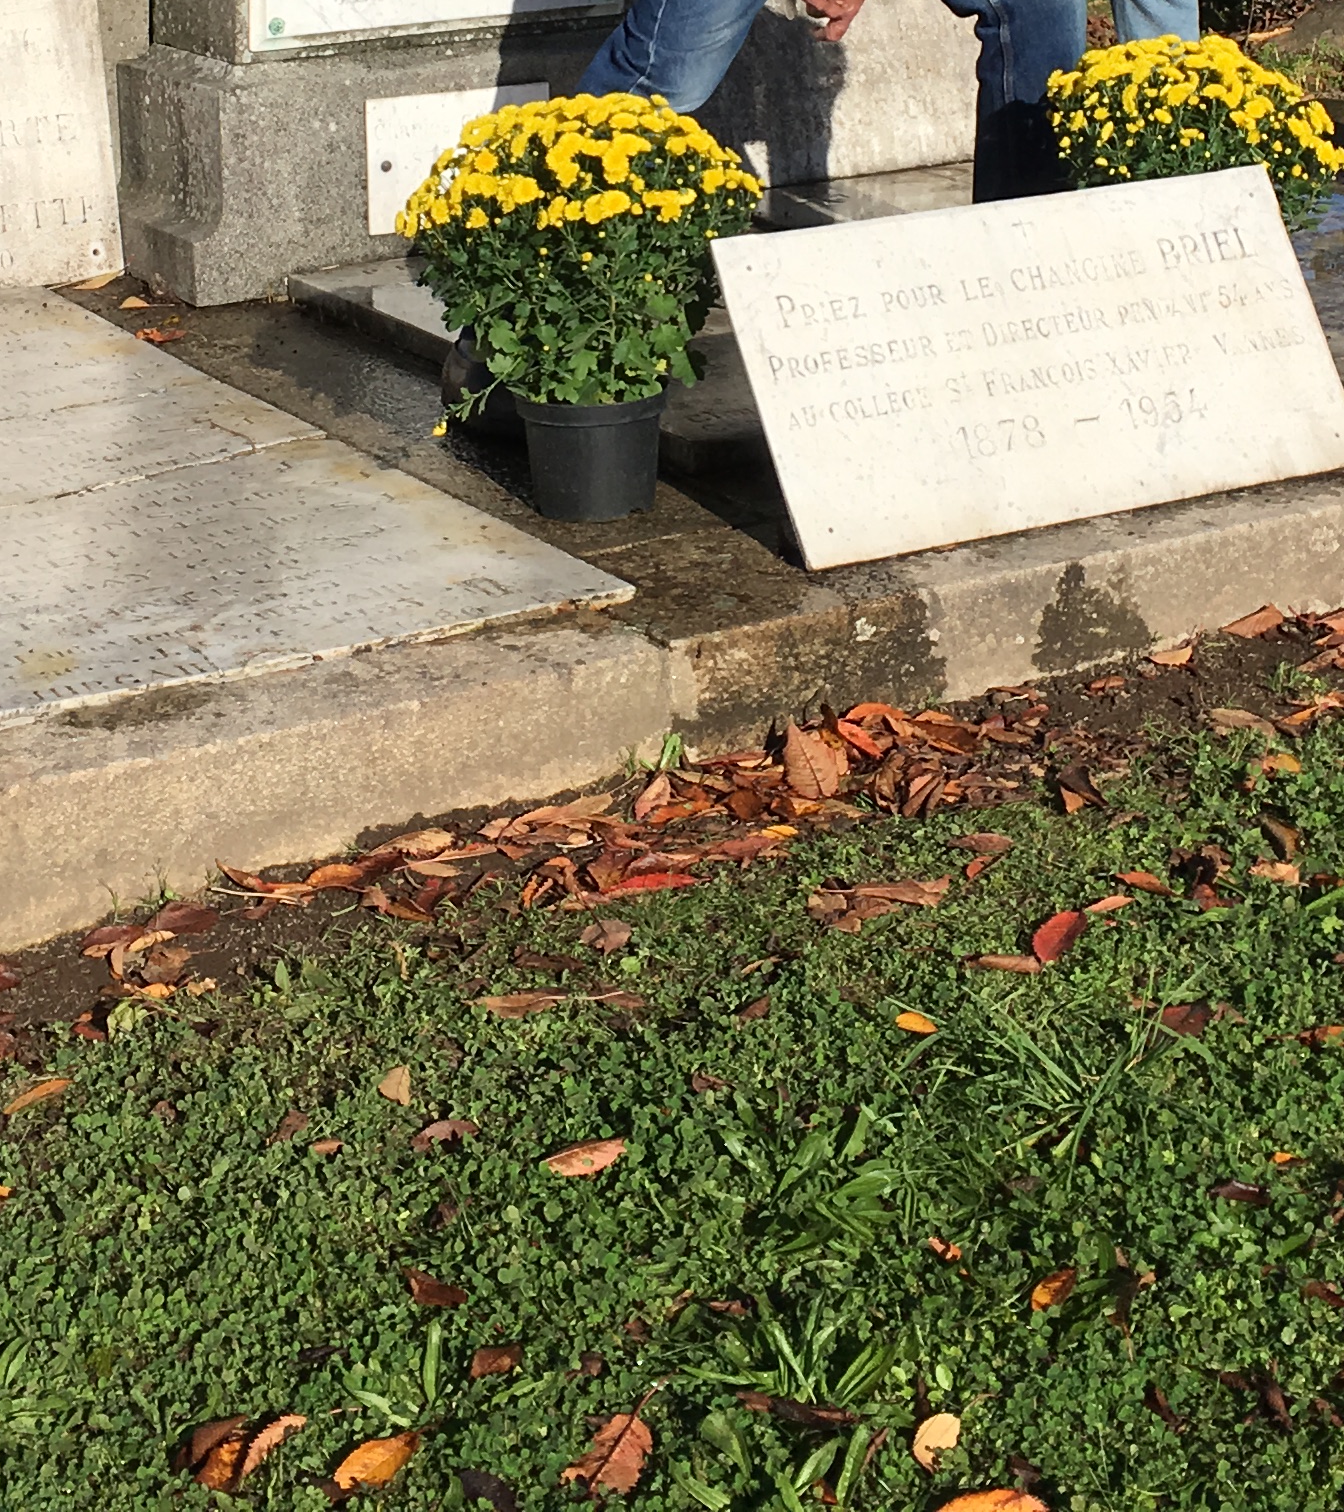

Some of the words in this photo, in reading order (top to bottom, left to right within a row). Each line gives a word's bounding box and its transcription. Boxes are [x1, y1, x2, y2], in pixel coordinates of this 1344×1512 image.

[775, 294, 867, 328] PRIEZ
[881, 283, 948, 312] POUR
[959, 276, 995, 302] LE
[1156, 227, 1259, 270] BRIEL
[768, 335, 939, 382] PROFESSEUR
[945, 328, 973, 353] ET
[981, 307, 1111, 347] DIRECTEUR
[788, 404, 817, 431] AU
[957, 414, 1048, 460] 1878
[1119, 387, 1208, 430] 1954
